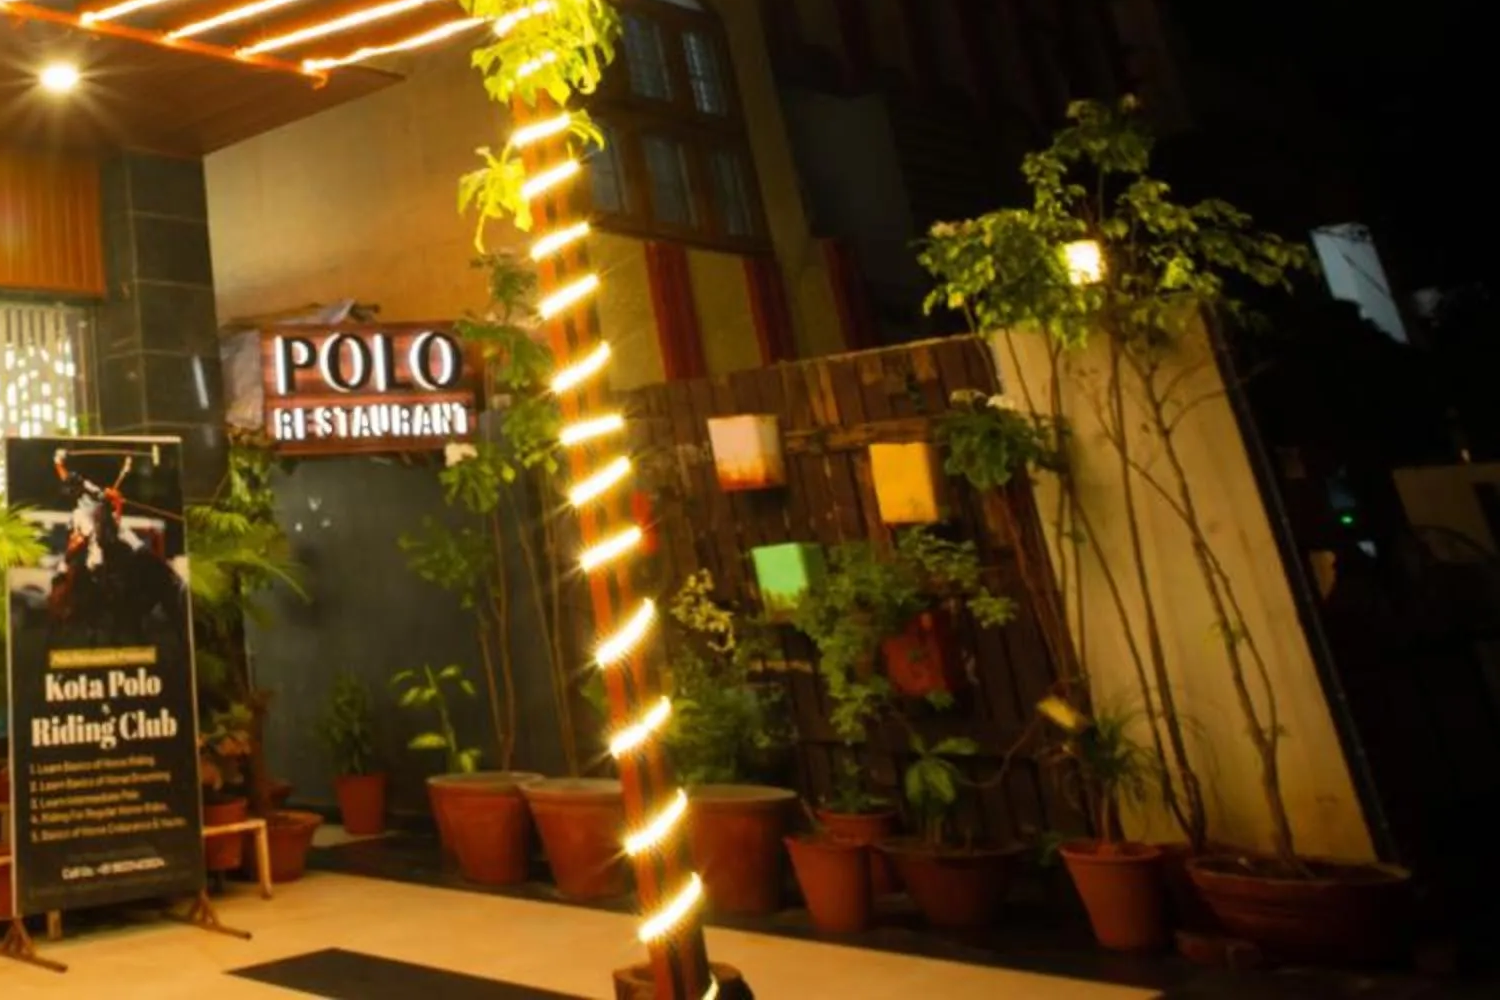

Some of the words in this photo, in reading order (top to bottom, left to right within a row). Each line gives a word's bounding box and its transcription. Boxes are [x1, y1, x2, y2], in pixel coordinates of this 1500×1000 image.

[274, 330, 463, 395] POLO
[274, 402, 469, 441] RESTAURANT
[45, 673, 104, 702] Kota
[108, 667, 162, 698] Polo
[31, 714, 117, 750] Riding
[119, 707, 177, 741] Club
